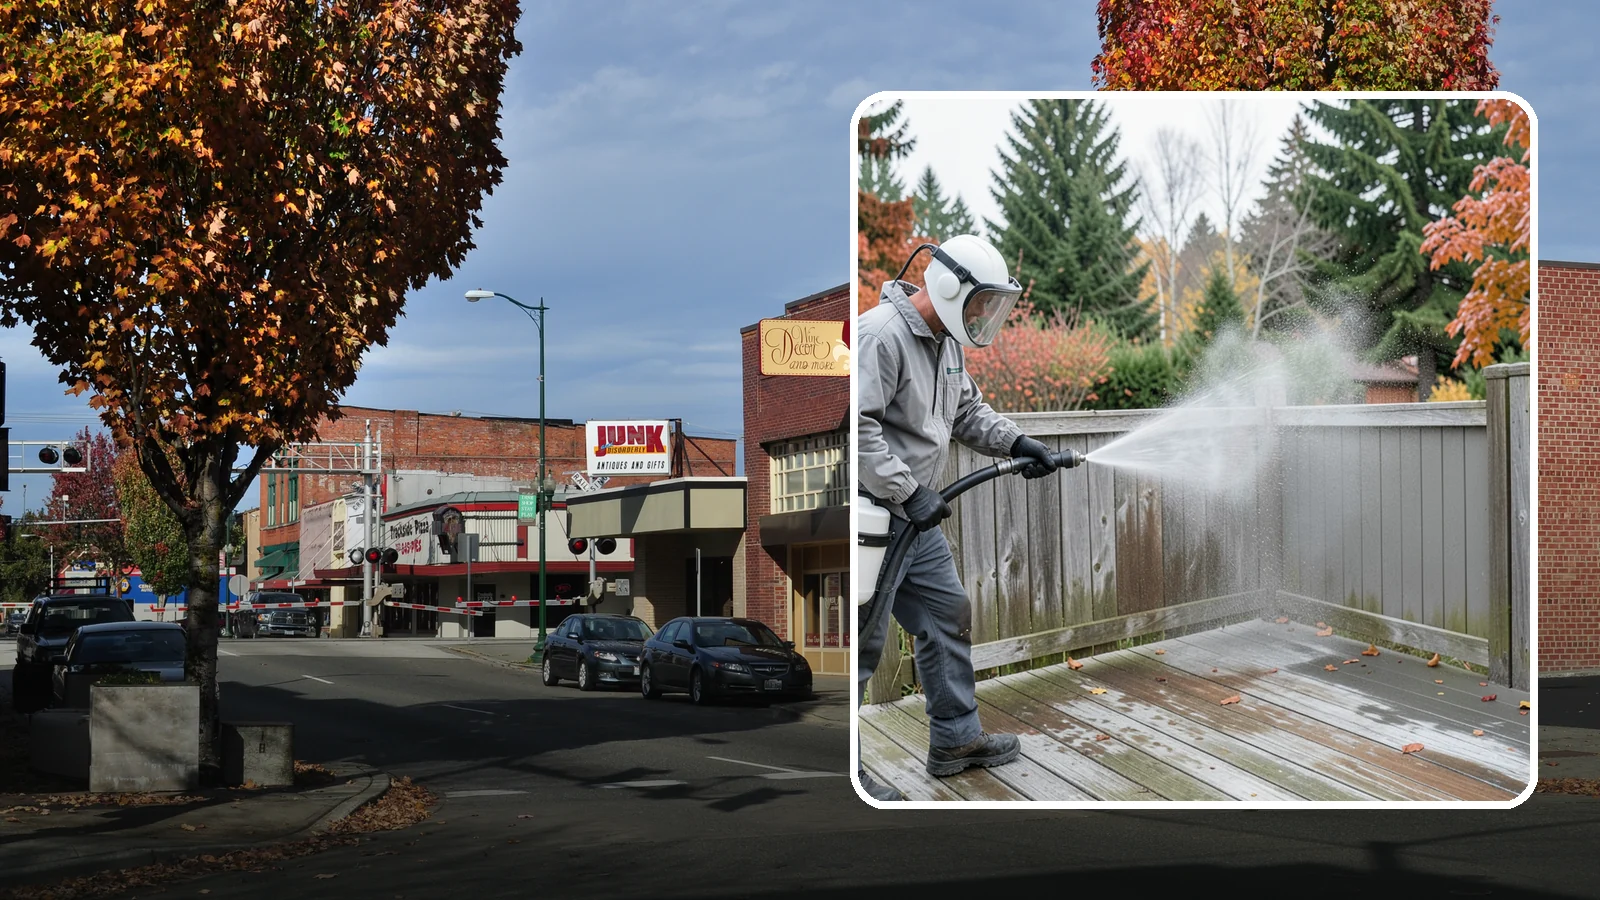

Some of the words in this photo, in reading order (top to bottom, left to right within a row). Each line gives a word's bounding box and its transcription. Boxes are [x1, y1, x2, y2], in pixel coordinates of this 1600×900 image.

[596, 425, 664, 457] JUNK
[607, 446, 646, 454] DISORDERLY
[597, 461, 628, 470] ANTIQUES
[631, 461, 644, 470] AND
[647, 460, 665, 469] GIFTS
[588, 476, 608, 492] SING
[415, 519, 429, 535] Pizza
